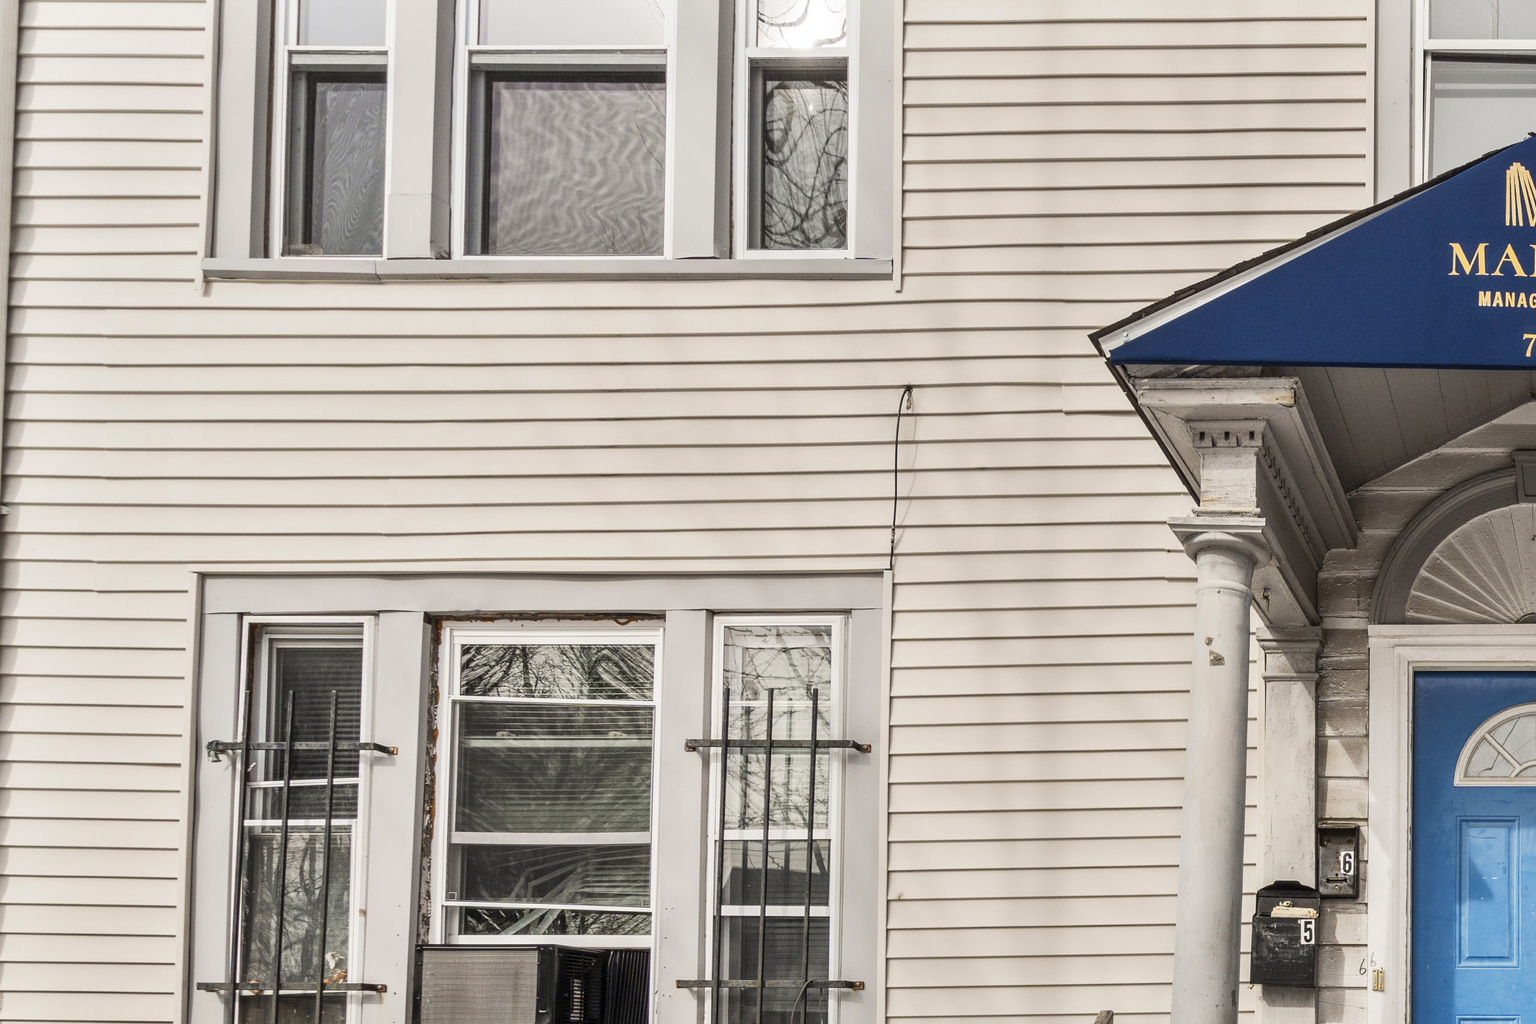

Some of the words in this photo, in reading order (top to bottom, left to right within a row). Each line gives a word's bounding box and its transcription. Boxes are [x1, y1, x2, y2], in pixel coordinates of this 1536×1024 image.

[1343, 853, 1352, 873] 6
[1304, 921, 1312, 942] 5
[1359, 959, 1367, 975] 6
